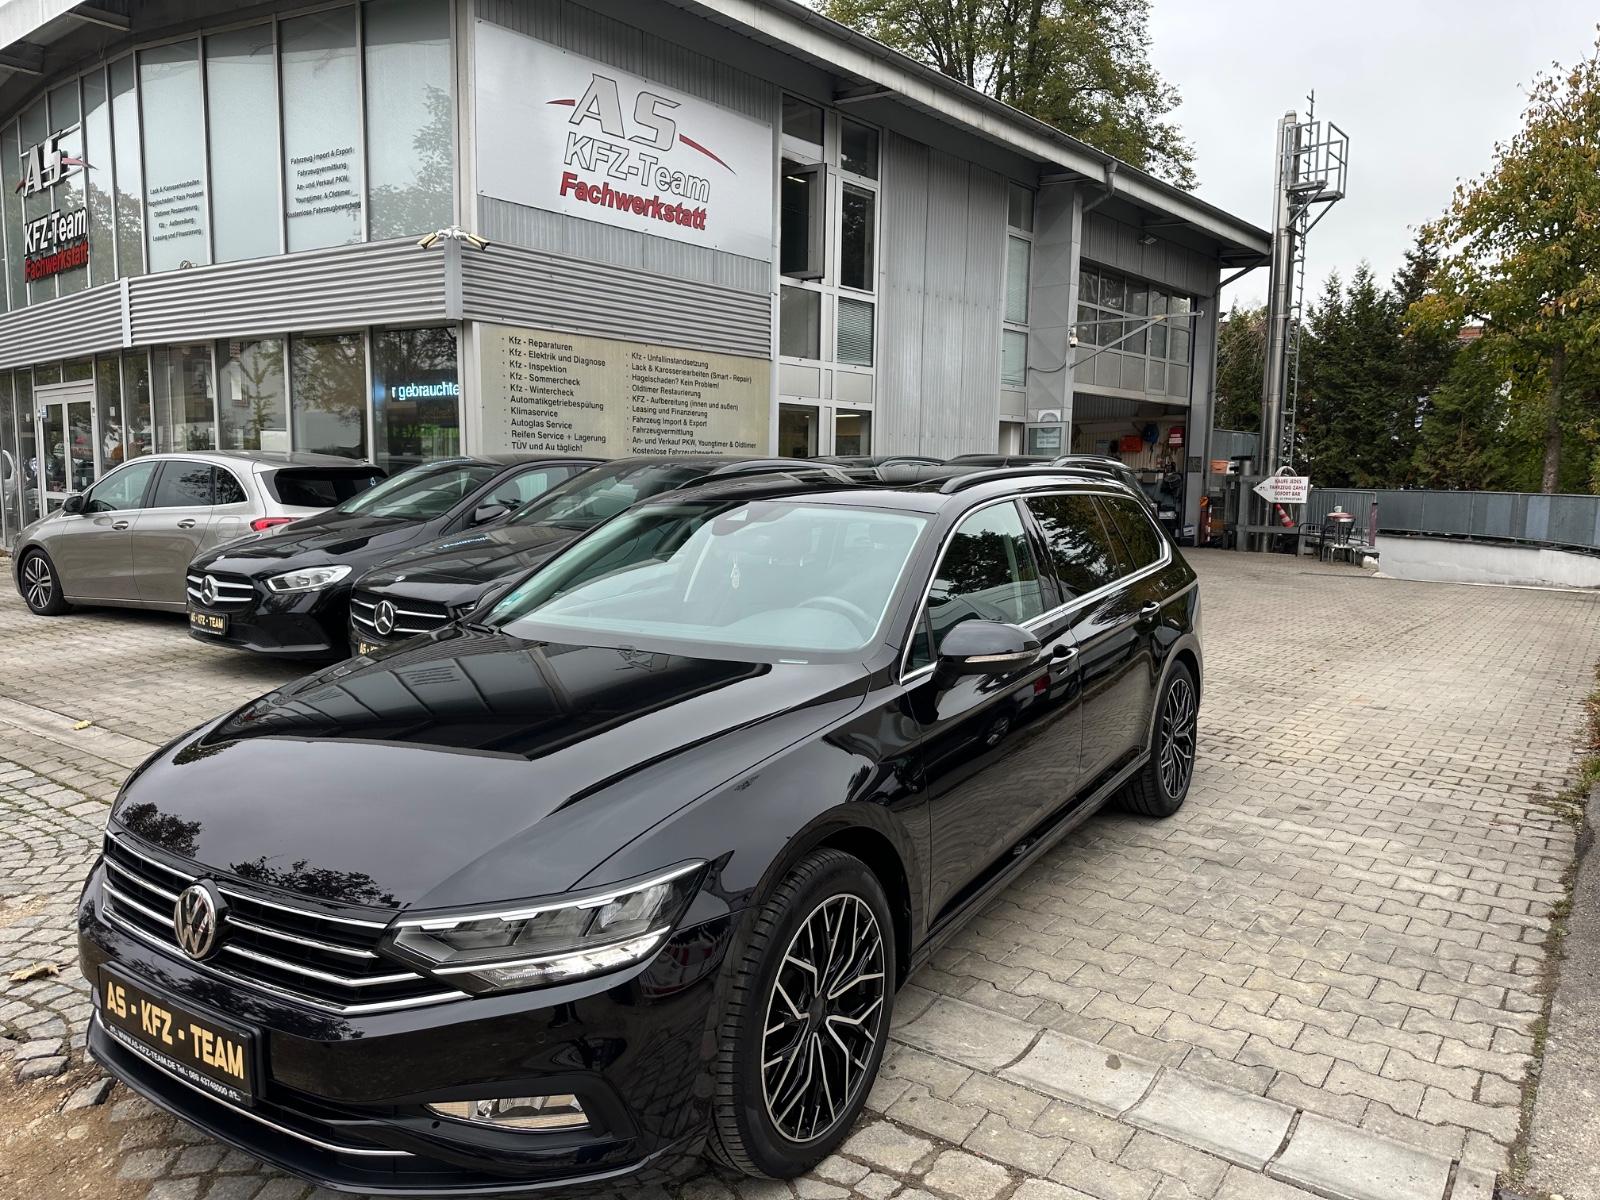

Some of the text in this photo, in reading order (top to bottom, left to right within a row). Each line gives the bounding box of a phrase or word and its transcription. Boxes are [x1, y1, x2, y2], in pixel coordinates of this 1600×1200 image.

[569, 73, 681, 152] AS
[290, 156, 313, 165] Fahrzeug
[314, 152, 330, 160] Import
[336, 147, 353, 156] Export
[23, 130, 62, 197] AS
[297, 163, 347, 176] Fahrzeugvermittlung
[564, 131, 710, 203] KFZ-Team
[316, 178, 334, 186] Verkauf
[329, 190, 351, 198] Oldtimer
[560, 171, 707, 230] Fachwerkstatt
[24, 207, 87, 256] KFZ-Team
[25, 239, 89, 283] Fachwerkstatt
[508, 336, 522, 345] Kfz
[528, 338, 573, 352] Reparaturen
[509, 348, 522, 356] Kfz
[528, 351, 556, 360] Elektrik
[558, 355, 572, 363] und
[574, 356, 606, 366] Diagnose
[632, 352, 642, 360] Kfz
[648, 354, 709, 369] Unfallinstandsetzung
[510, 360, 522, 368] Kfz
[529, 362, 567, 373] Inspektion
[632, 364, 646, 372] Lack
[654, 365, 710, 378] Karosseriearbeiten
[510, 372, 522, 380] Kfz
[529, 374, 580, 386] Sommercheck
[632, 374, 679, 384] Hagelschaden?
[694, 381, 720, 389] Problem!
[398, 382, 460, 400] gebrauchte
[510, 384, 522, 392] Kfz
[530, 386, 574, 396] Wintercheck
[632, 385, 701, 398] Oldtimer Restaurierung
[510, 395, 604, 411] Automatikgetriebespülung
[650, 397, 688, 407] Aufbereitung
[690, 399, 708, 408] (innen
[720, 402, 738, 411] außen)
[510, 407, 558, 418] Klimaservice
[632, 406, 656, 415] Leasing
[671, 408, 708, 418] Finanzierung
[511, 418, 572, 430] Autoglas Service
[632, 416, 660, 425] Fahrzeug
[662, 418, 682, 426] Import
[689, 420, 708, 428] Export
[512, 430, 536, 438] Reifen
[538, 432, 564, 440] Service
[574, 434, 606, 443] Lagerung
[632, 426, 694, 437] Fahrzeugvermittlung
[512, 440, 528, 450] TÜV
[529, 442, 544, 450] und
[557, 444, 583, 453] täglich!
[658, 438, 680, 446] Verkauf
[698, 440, 728, 448] Youngtimer
[208, 616, 224, 628] TEAM
[107, 981, 244, 1080] AS - KFZ - TEAM
